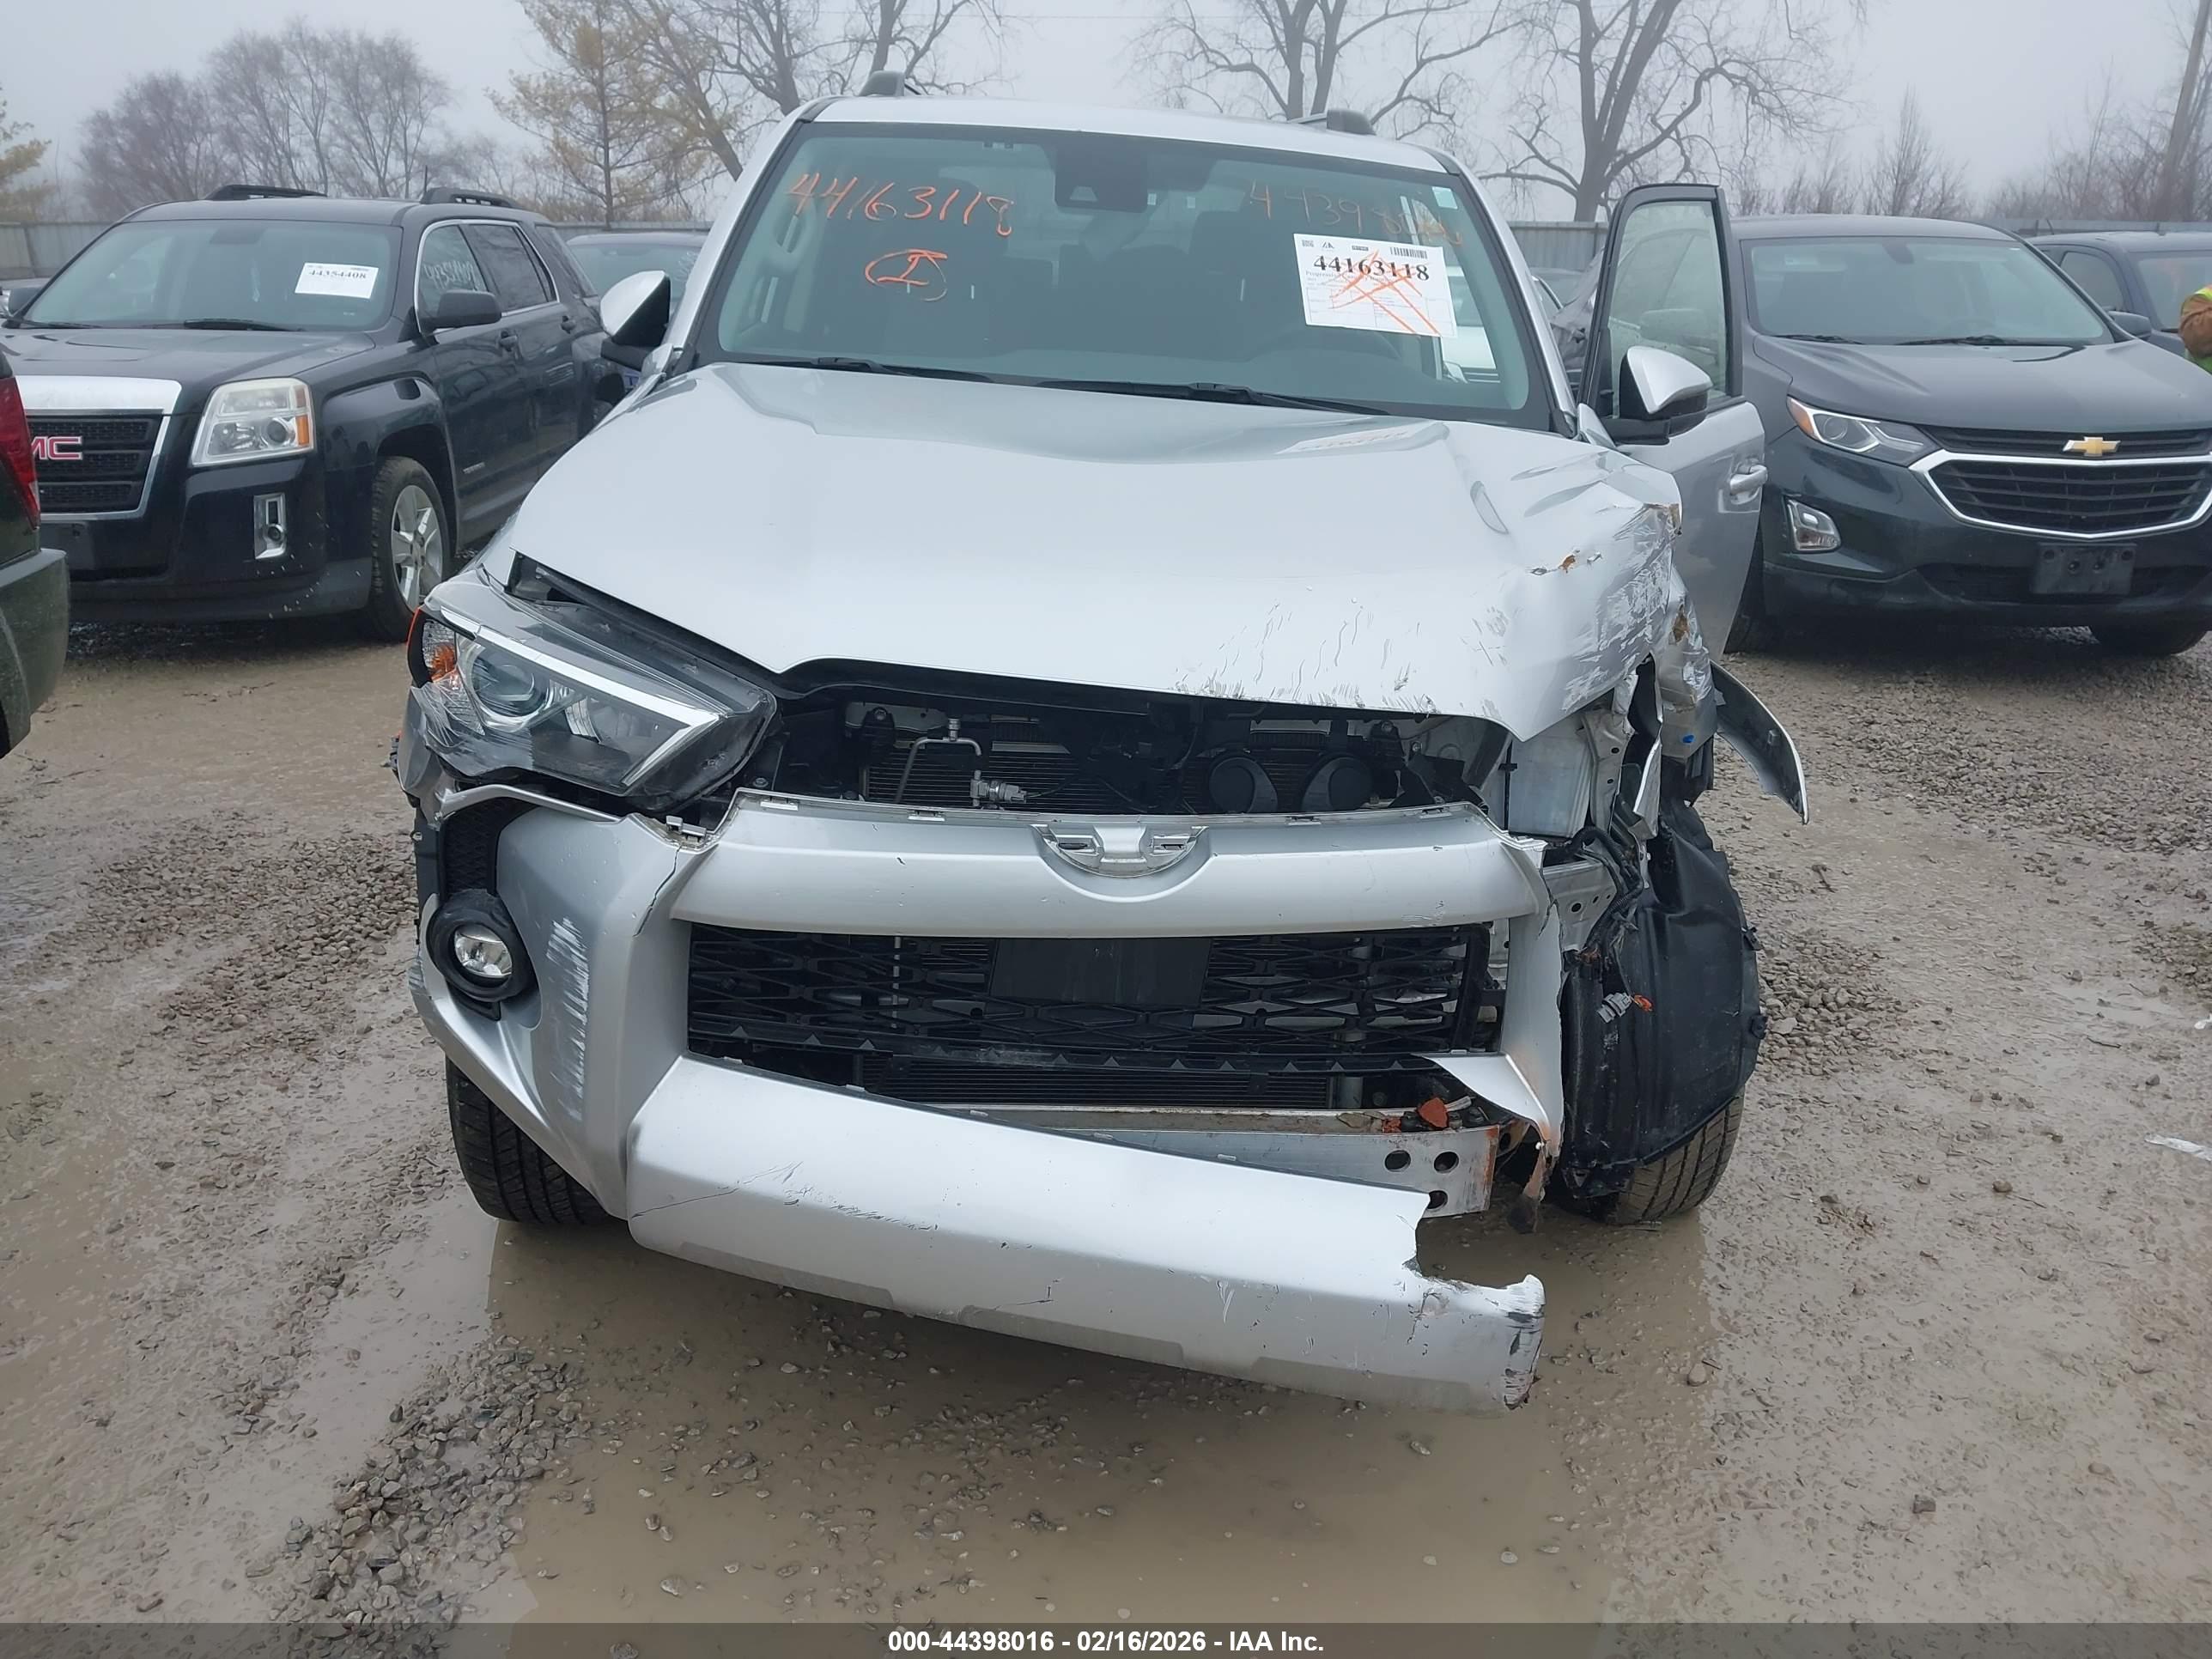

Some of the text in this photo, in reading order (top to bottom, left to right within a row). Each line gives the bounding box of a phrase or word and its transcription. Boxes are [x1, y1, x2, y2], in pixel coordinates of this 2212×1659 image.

[785, 173, 1015, 236] 44163118
[1314, 255, 1430, 282] 44163118
[31, 436, 83, 460] MC
